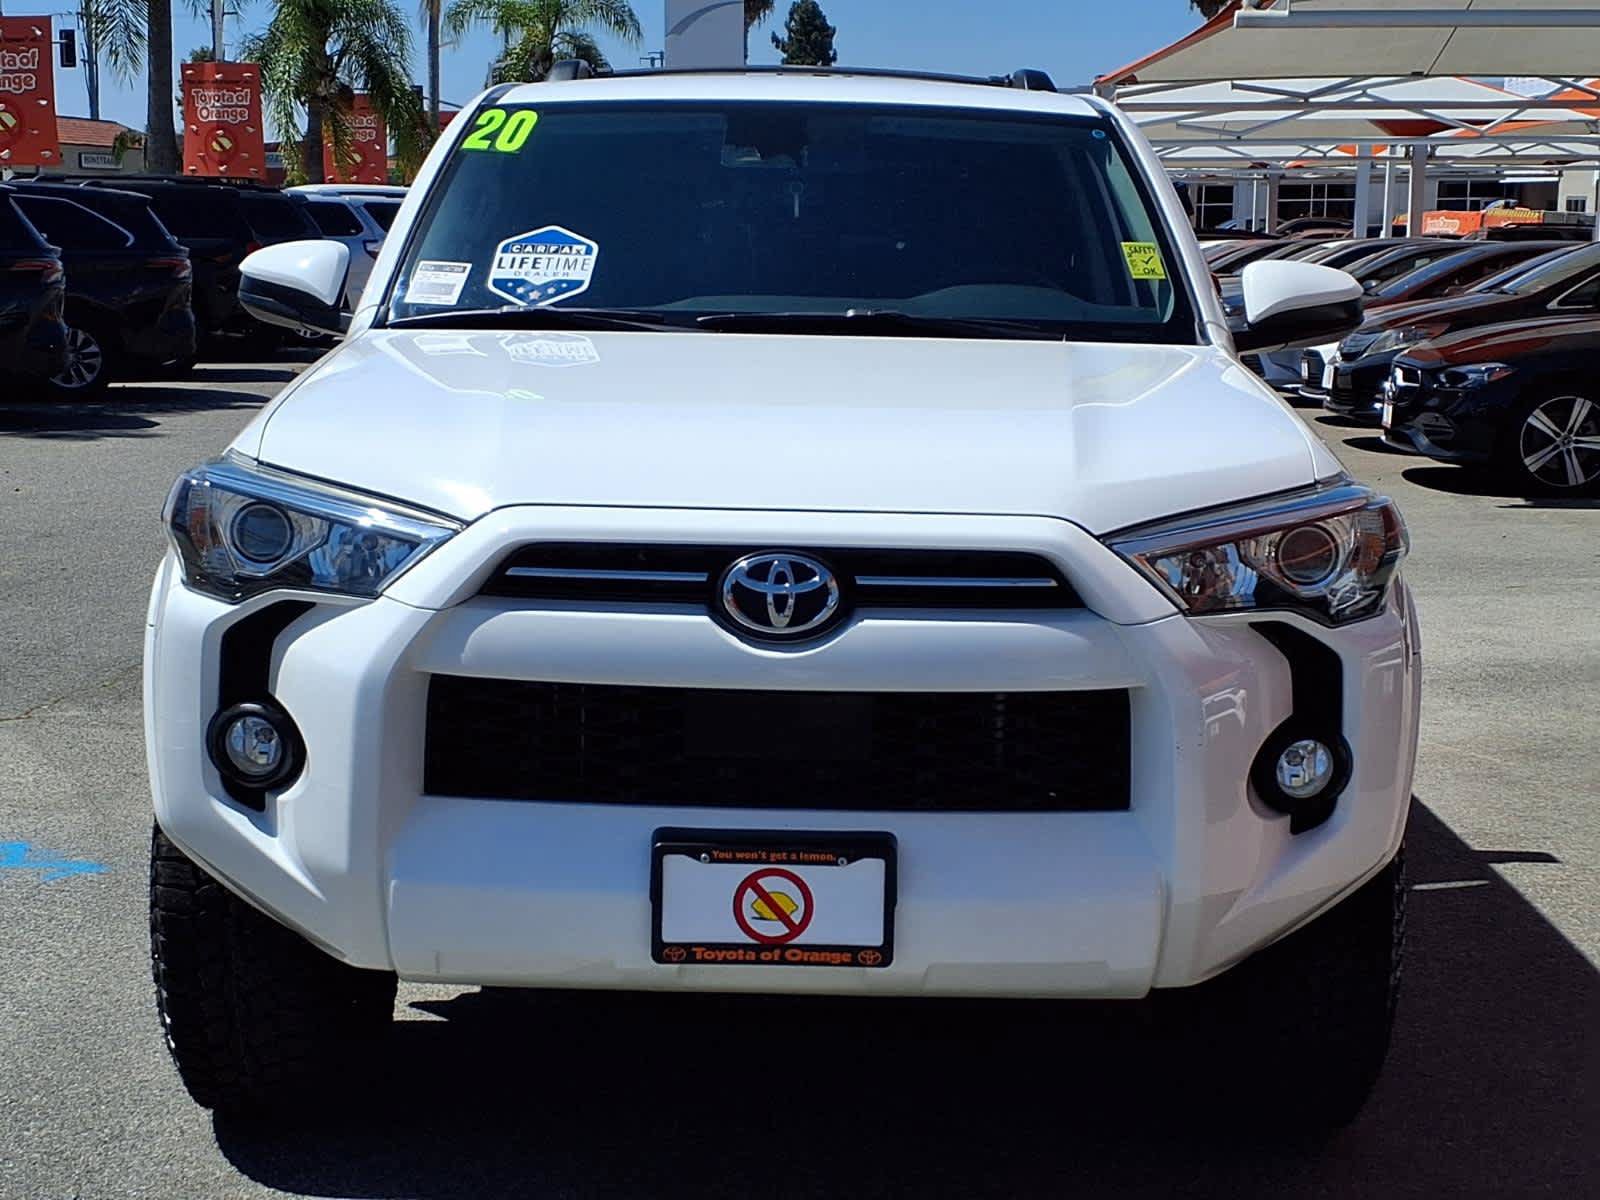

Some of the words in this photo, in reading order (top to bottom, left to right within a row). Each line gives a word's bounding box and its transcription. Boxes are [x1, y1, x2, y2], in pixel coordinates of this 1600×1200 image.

[19, 48, 38, 68] of
[192, 89, 234, 107] Toyota
[235, 89, 250, 105] of
[197, 107, 248, 123] Orange
[461, 108, 539, 152] 20
[510, 244, 586, 255] CARFAX
[497, 256, 591, 271] LIFETIME
[712, 850, 732, 859] You
[736, 850, 766, 860] won't
[769, 852, 787, 862] get
[799, 852, 836, 862] lemon.
[692, 947, 755, 961] Toyota
[760, 949, 780, 961] of
[785, 949, 851, 964] Orange
